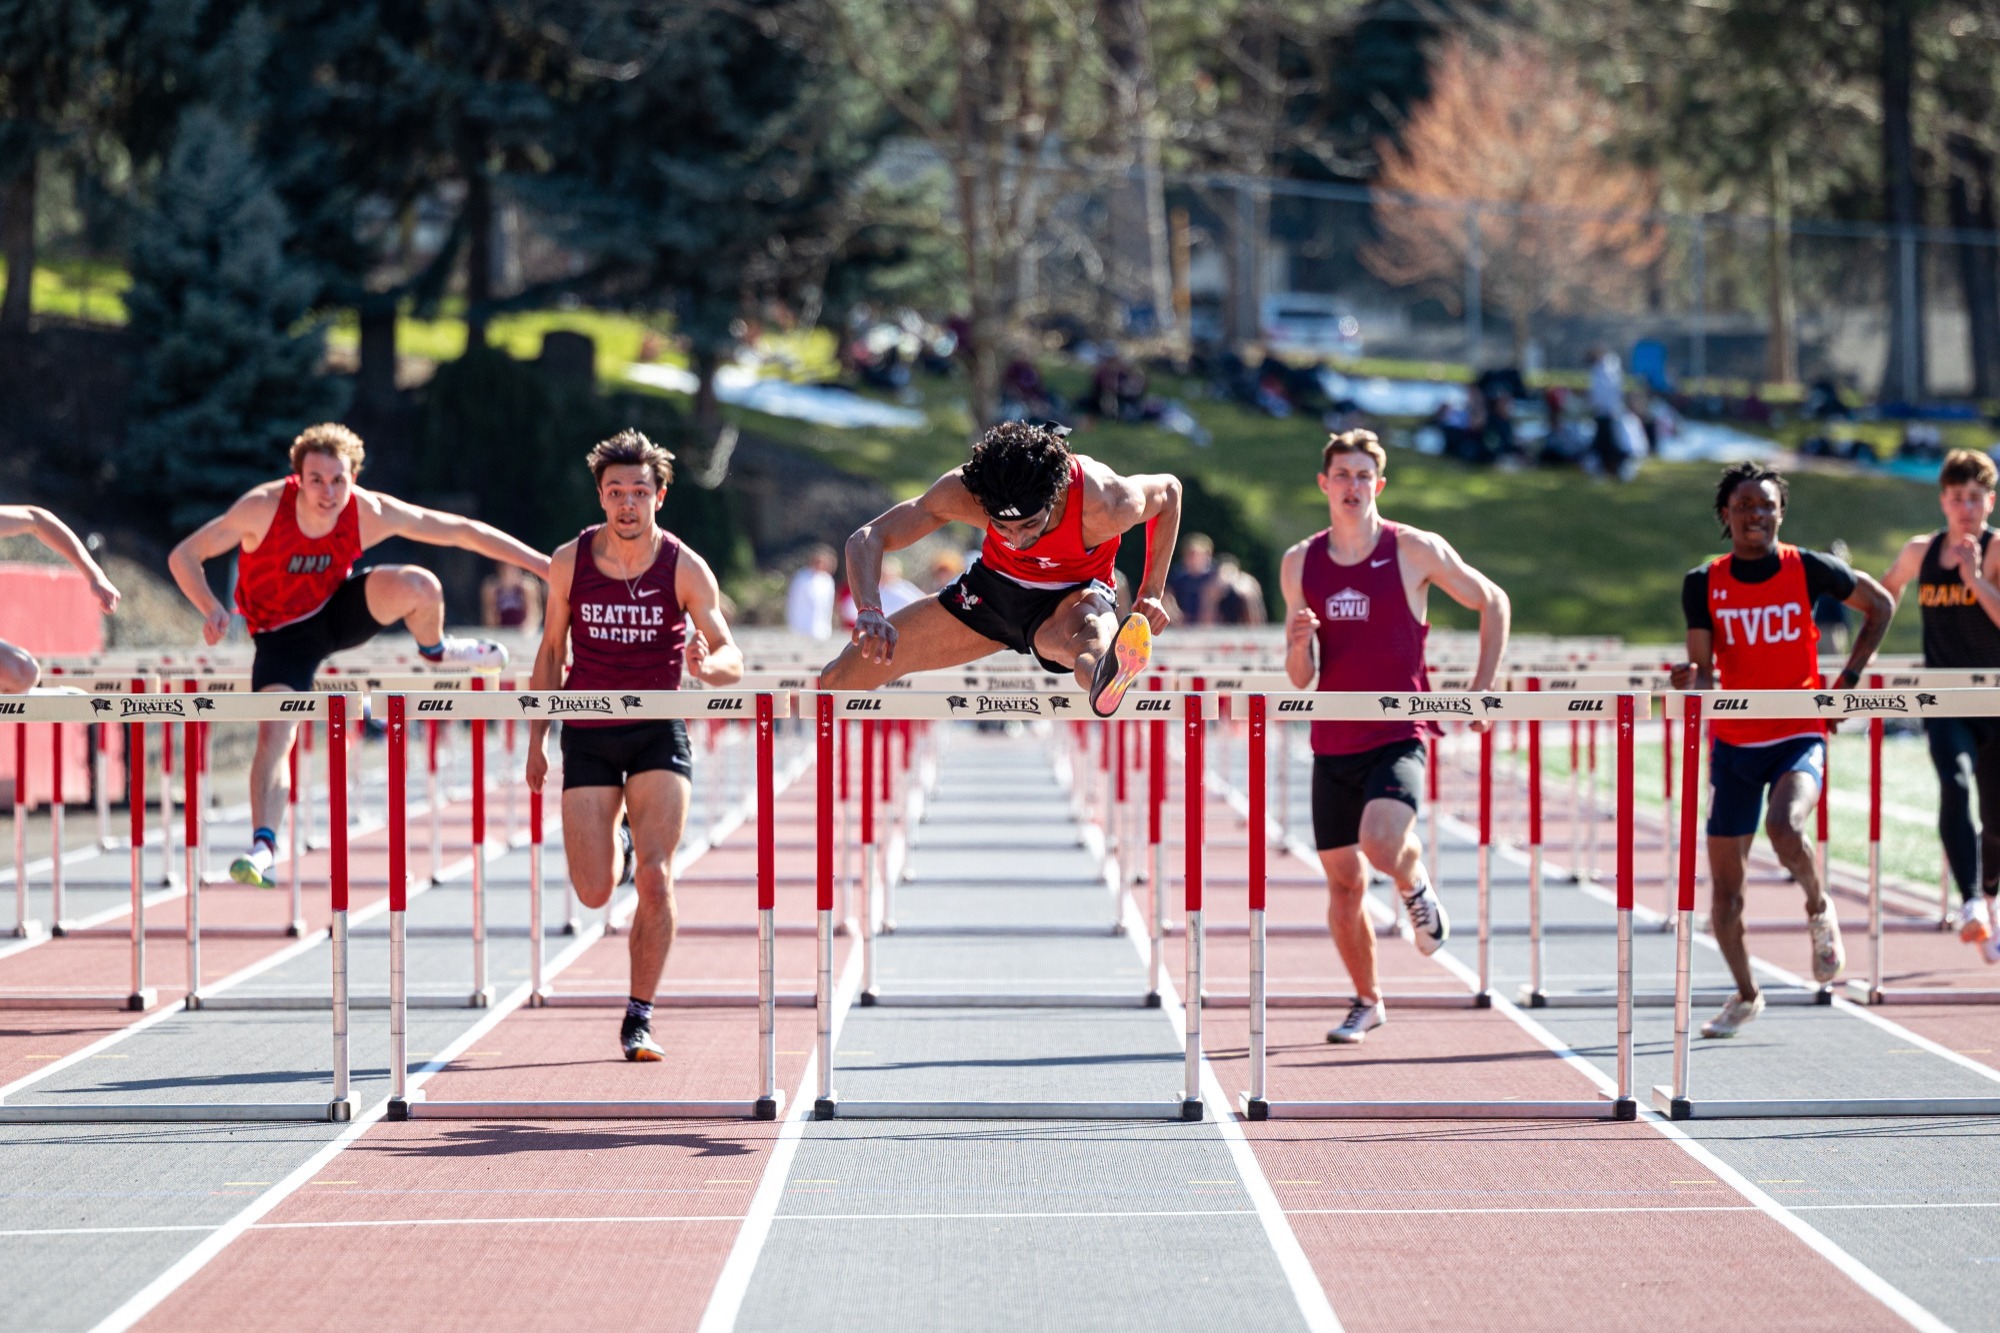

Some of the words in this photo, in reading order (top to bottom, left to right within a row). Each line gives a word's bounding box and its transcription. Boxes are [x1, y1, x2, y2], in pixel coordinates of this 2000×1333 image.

[581, 603, 664, 626] SEATTLE
[1328, 599, 1367, 617] CWU
[1716, 602, 1802, 646] TVCC
[588, 626, 658, 643] PACIFIC
[120, 698, 184, 714] PIRATES
[280, 700, 316, 711] GILL
[418, 700, 453, 711] GILL
[547, 695, 611, 712] PIRATES
[707, 698, 743, 709] GILL
[846, 699, 881, 710] GILL
[976, 695, 1039, 713] PIRATES
[1136, 700, 1171, 710] GILL
[1278, 700, 1314, 711] GILL
[1408, 696, 1471, 713] PIRATES
[1568, 700, 1603, 711] GILL
[1713, 699, 1748, 710] GILL
[1843, 693, 1906, 710] PIRATES
